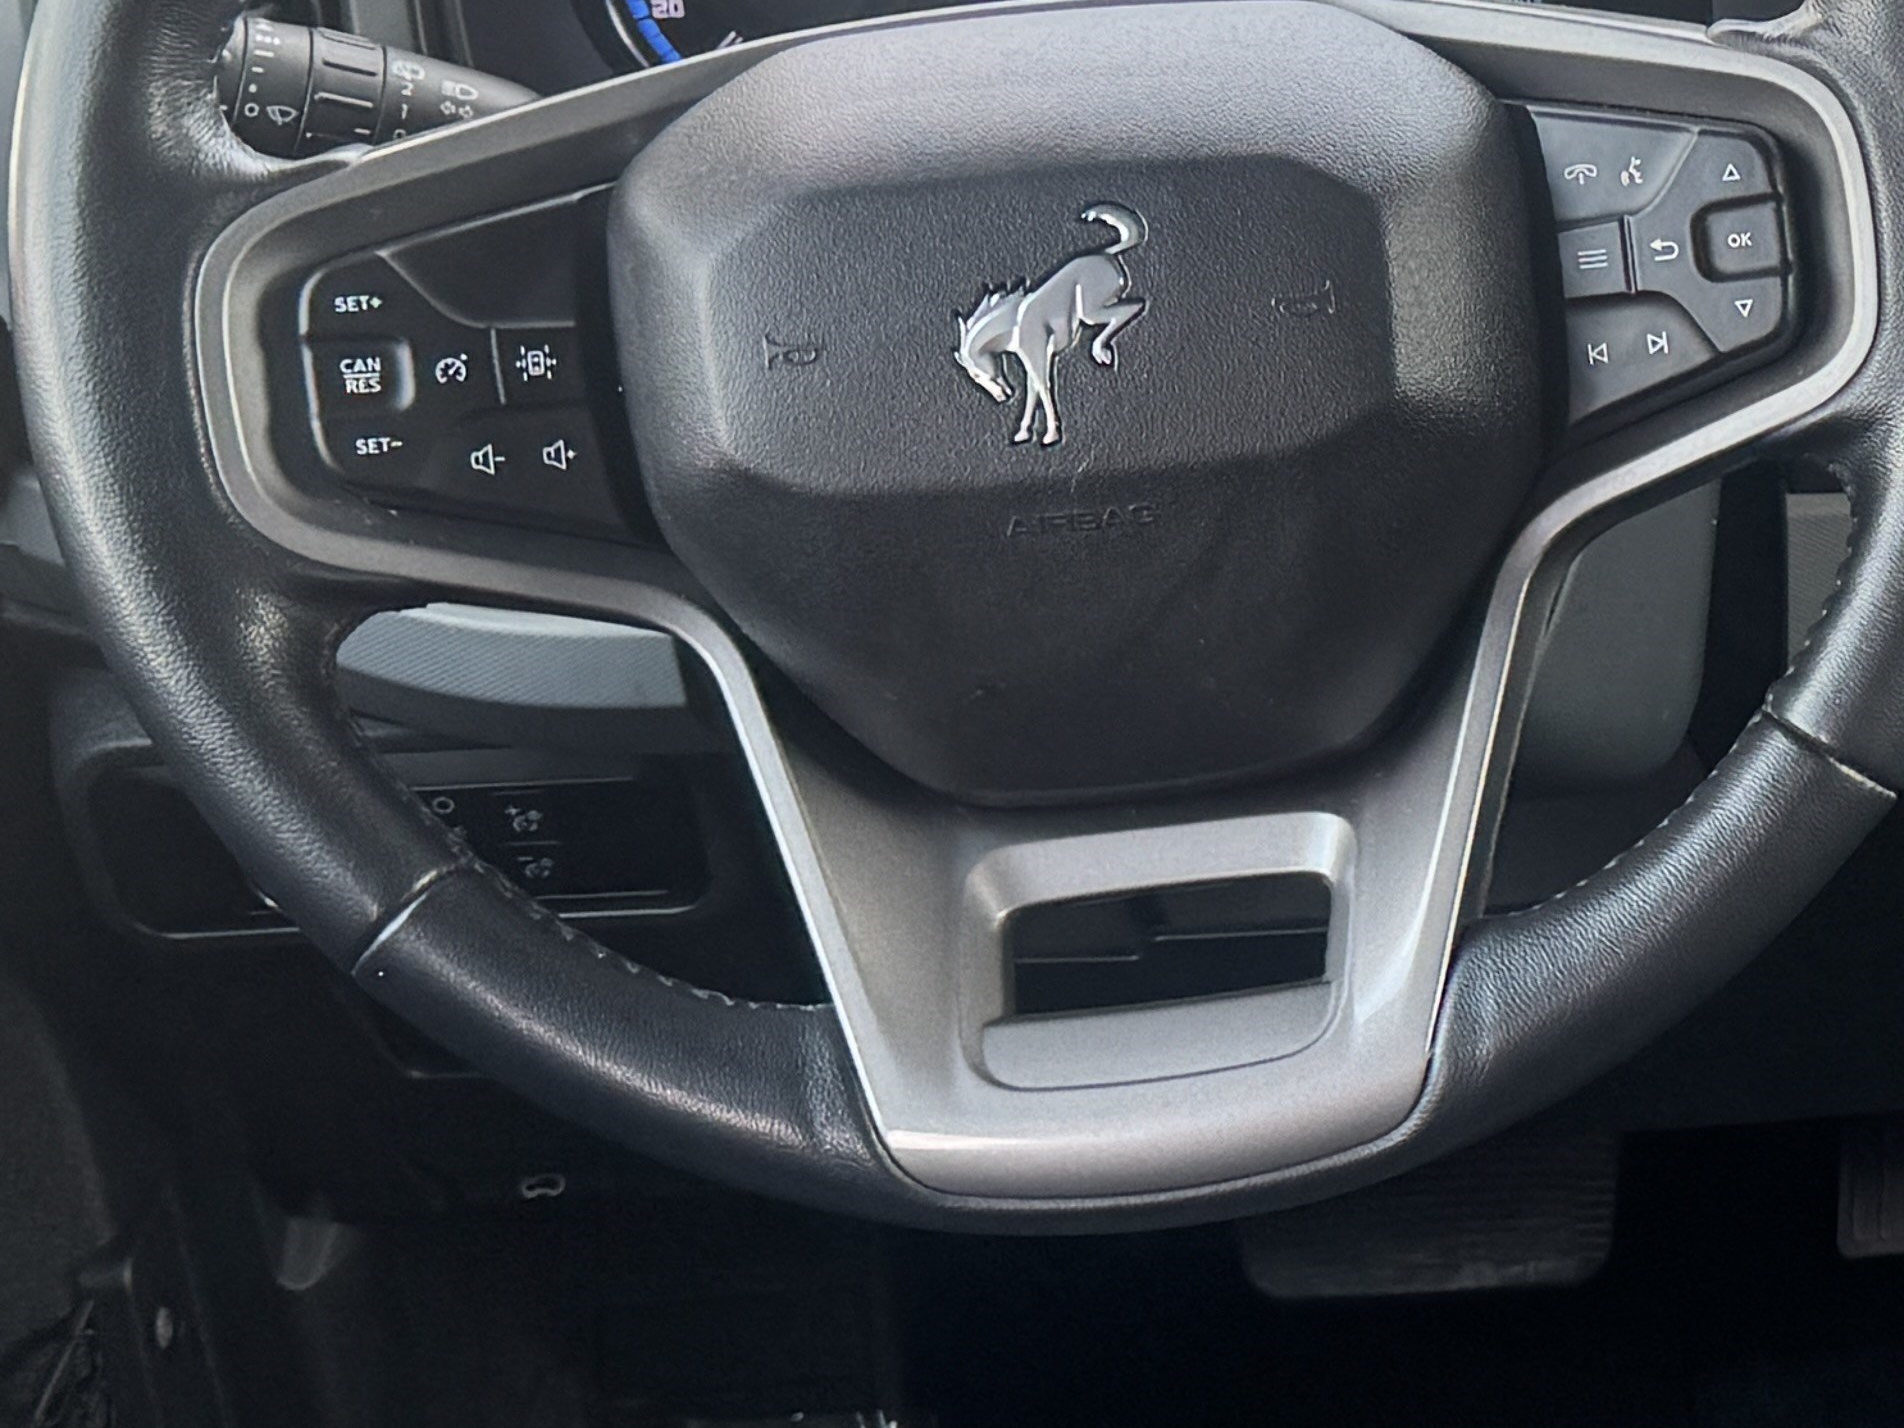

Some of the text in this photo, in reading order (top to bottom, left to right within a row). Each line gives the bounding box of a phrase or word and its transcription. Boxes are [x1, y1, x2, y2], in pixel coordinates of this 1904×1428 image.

[1726, 231, 1753, 249] OK
[339, 357, 382, 372] CAN
[345, 377, 382, 394] RES
